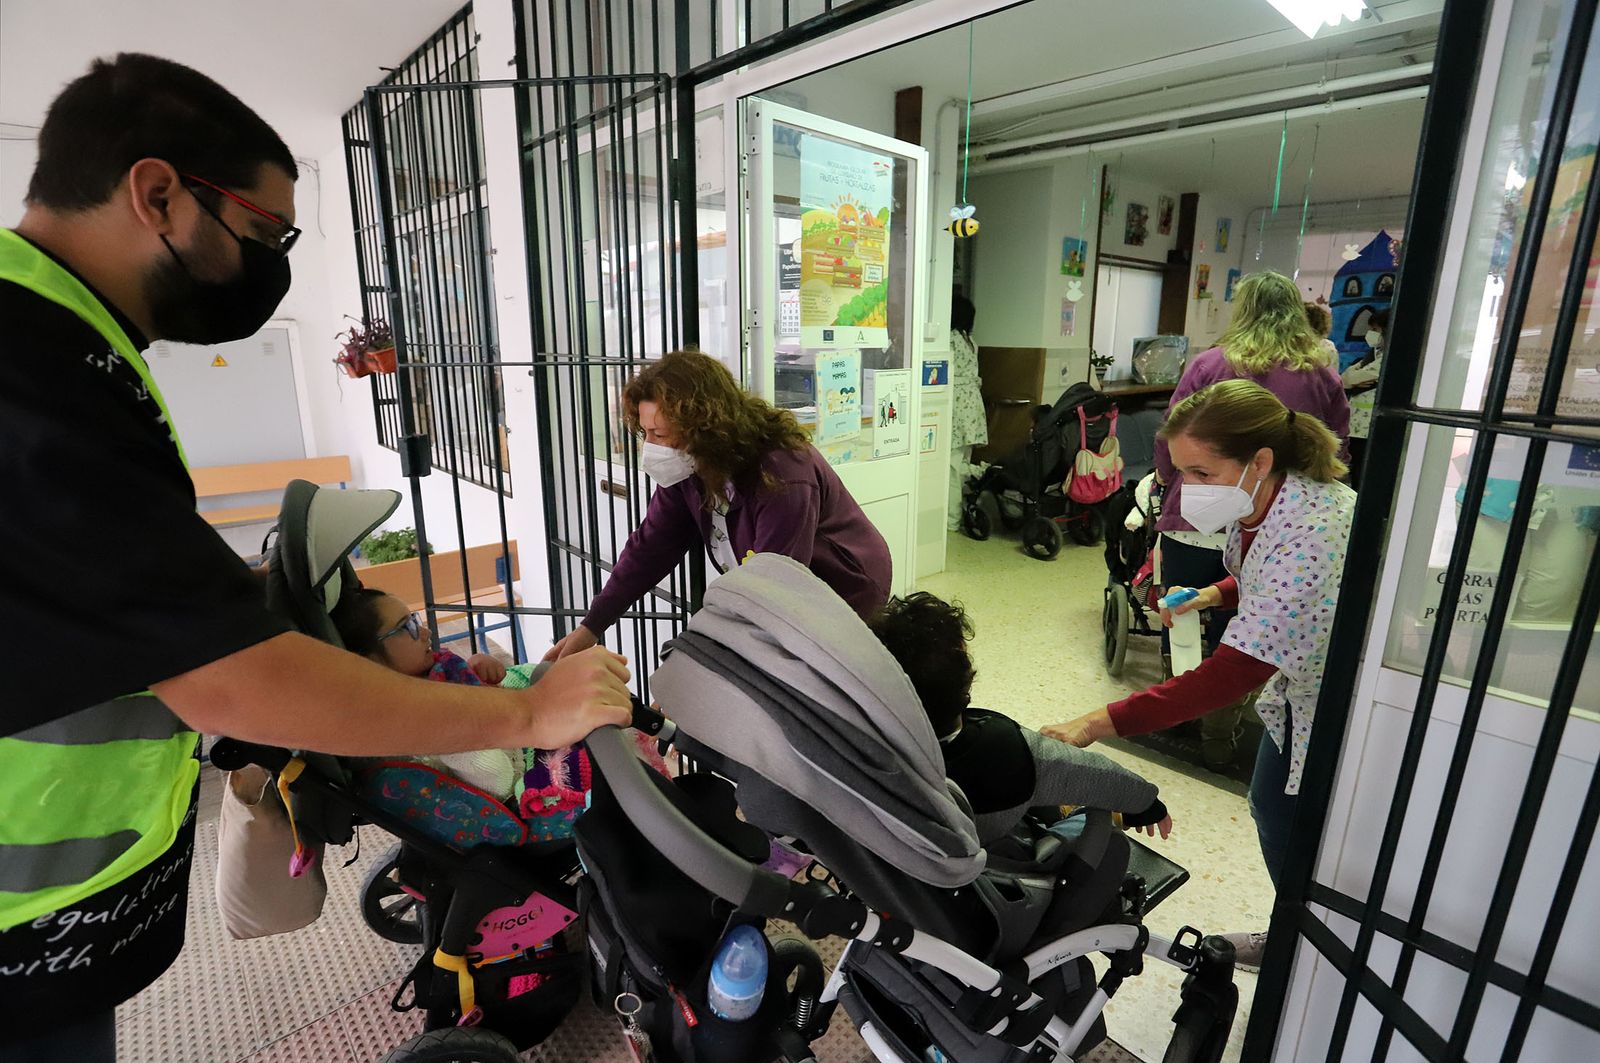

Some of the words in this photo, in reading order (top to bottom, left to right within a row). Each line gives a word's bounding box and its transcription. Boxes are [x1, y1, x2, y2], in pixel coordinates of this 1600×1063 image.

[883, 437, 900, 445] ENTRADA
[1436, 571, 1496, 588] CRRA
[1457, 592, 1483, 606] AS
[110, 893, 178, 955] noise
